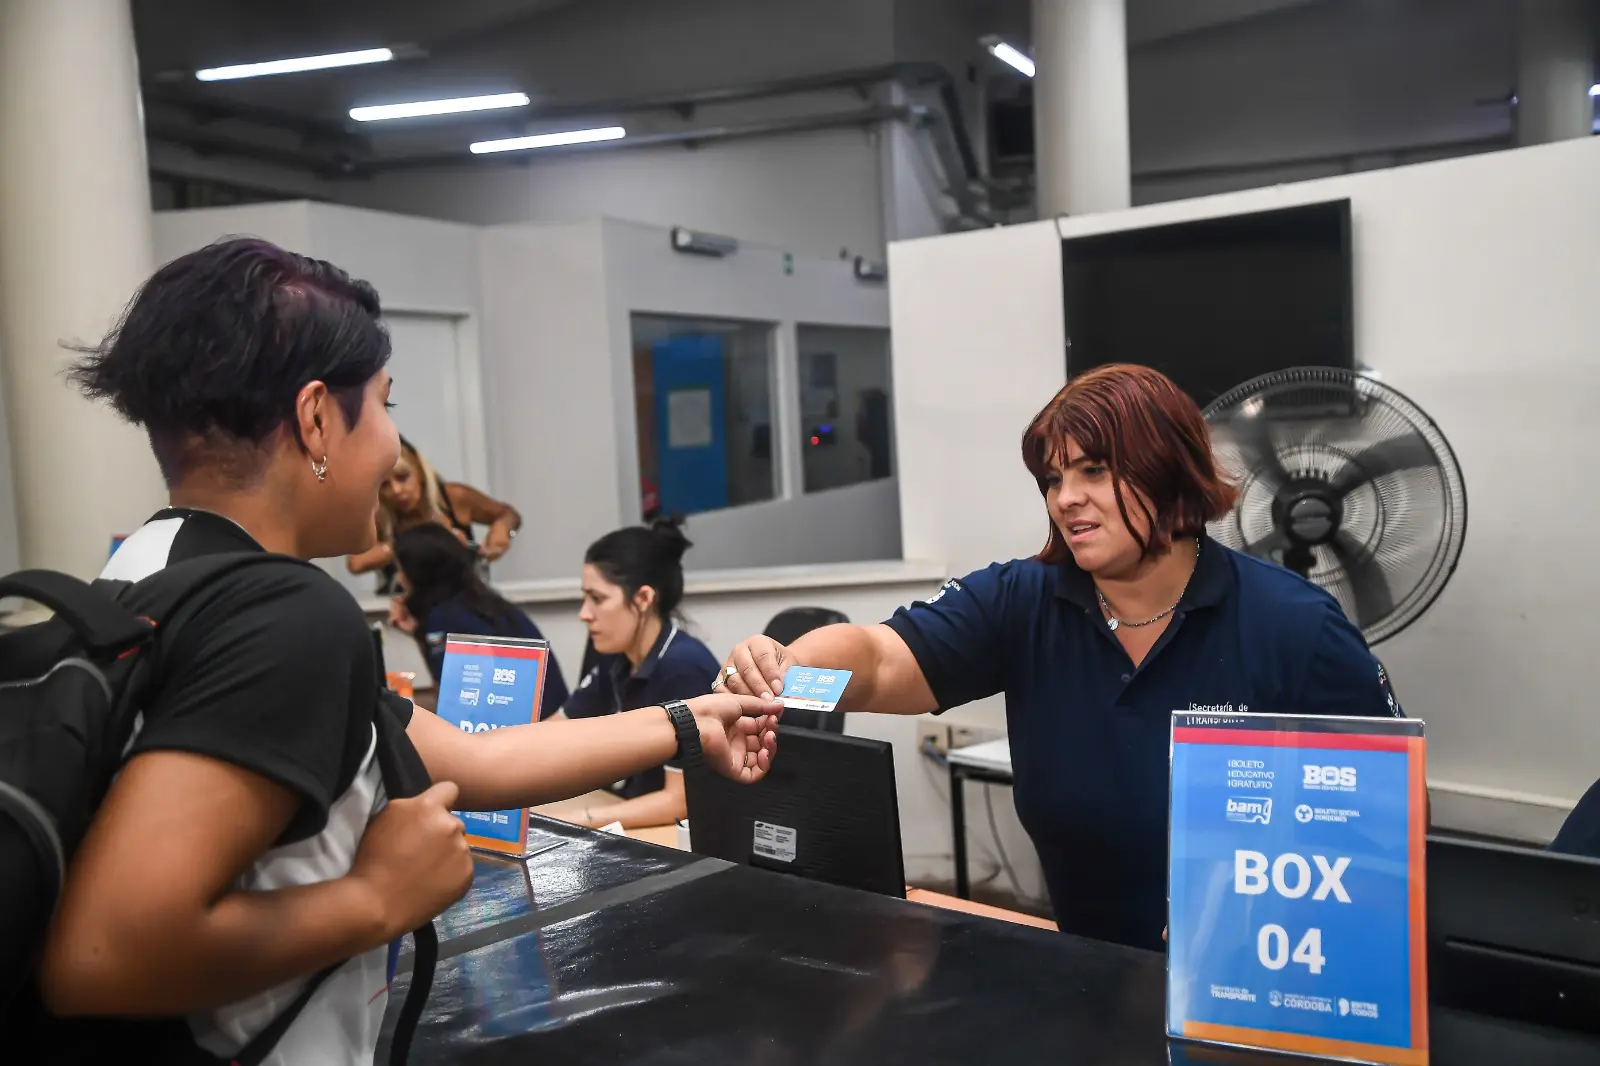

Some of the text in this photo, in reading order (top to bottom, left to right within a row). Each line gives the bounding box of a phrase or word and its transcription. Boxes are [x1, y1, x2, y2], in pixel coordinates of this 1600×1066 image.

[1192, 701, 1249, 712] Secretaría de
[1231, 760, 1265, 769] BOLETO
[1231, 770, 1275, 780] EDUCATIVO
[1303, 765, 1357, 787] BOS
[1231, 779, 1273, 789] GRATUITO
[1235, 850, 1352, 903] BOX
[1257, 923, 1326, 975] 04
